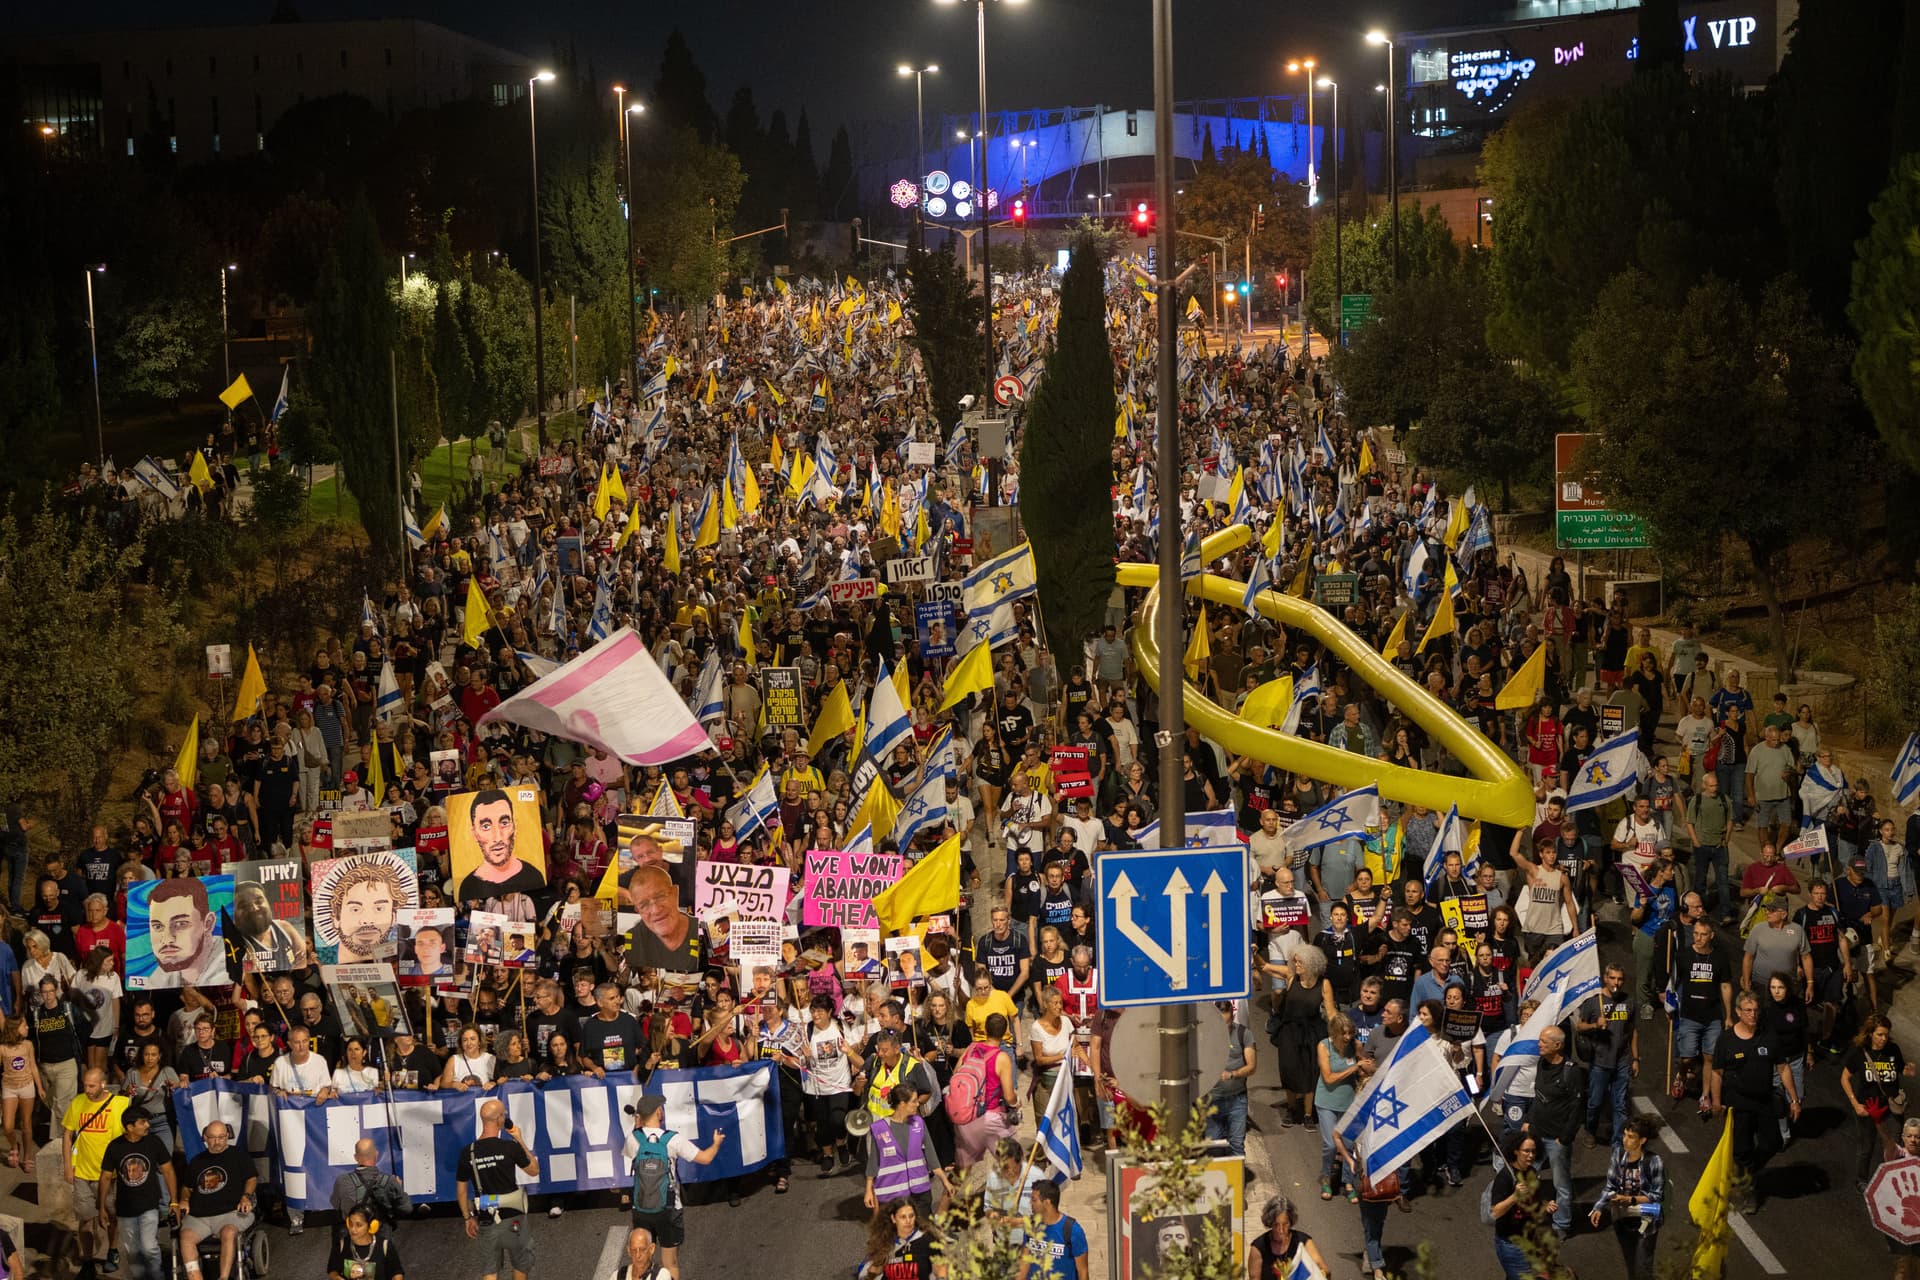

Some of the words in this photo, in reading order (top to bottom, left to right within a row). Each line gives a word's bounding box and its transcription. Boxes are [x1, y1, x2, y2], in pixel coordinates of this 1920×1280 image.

[1707, 16, 1757, 48] VIP
[1451, 50, 1501, 64] cinema
[1451, 64, 1478, 79] city
[1584, 498, 1606, 506] Muse
[1562, 514, 1597, 524] העברית
[1604, 536, 1649, 545] Universit
[893, 558, 929, 581] לאלון
[928, 584, 964, 602] סתכלו
[769, 688, 795, 698] הפקרת
[767, 698, 799, 707] החטופים
[787, 714, 799, 724] את
[258, 861, 299, 884] לאיתן
[809, 856, 839, 876] WE
[850, 856, 901, 878] WONT
[705, 865, 775, 889] מבצע
[278, 882, 300, 904] אין
[703, 888, 774, 913] הפקרת
[273, 901, 300, 922] זמן!
